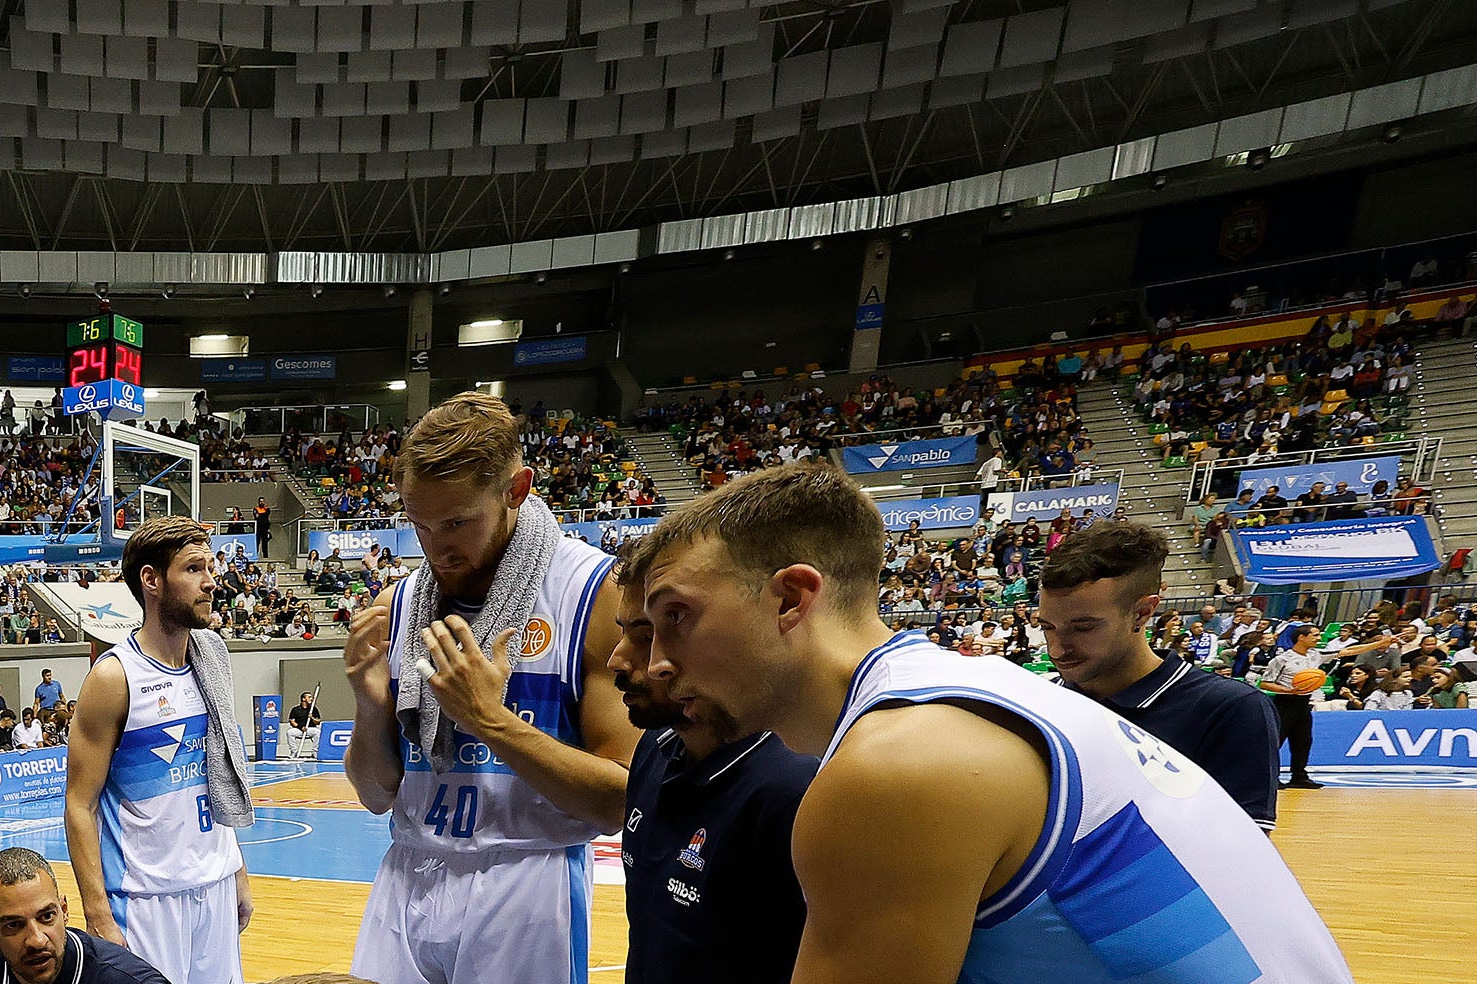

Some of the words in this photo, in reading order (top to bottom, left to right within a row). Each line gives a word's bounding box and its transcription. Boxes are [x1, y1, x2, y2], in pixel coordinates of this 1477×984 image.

[70, 346, 107, 387] 24
[114, 346, 142, 386] 24
[275, 358, 332, 370] Gescomes
[66, 399, 109, 414] LEXUS
[114, 398, 143, 413] LEXUS
[1015, 494, 1112, 513] CALAMARK
[140, 681, 173, 694] GIVOVA
[424, 783, 478, 838] 40
